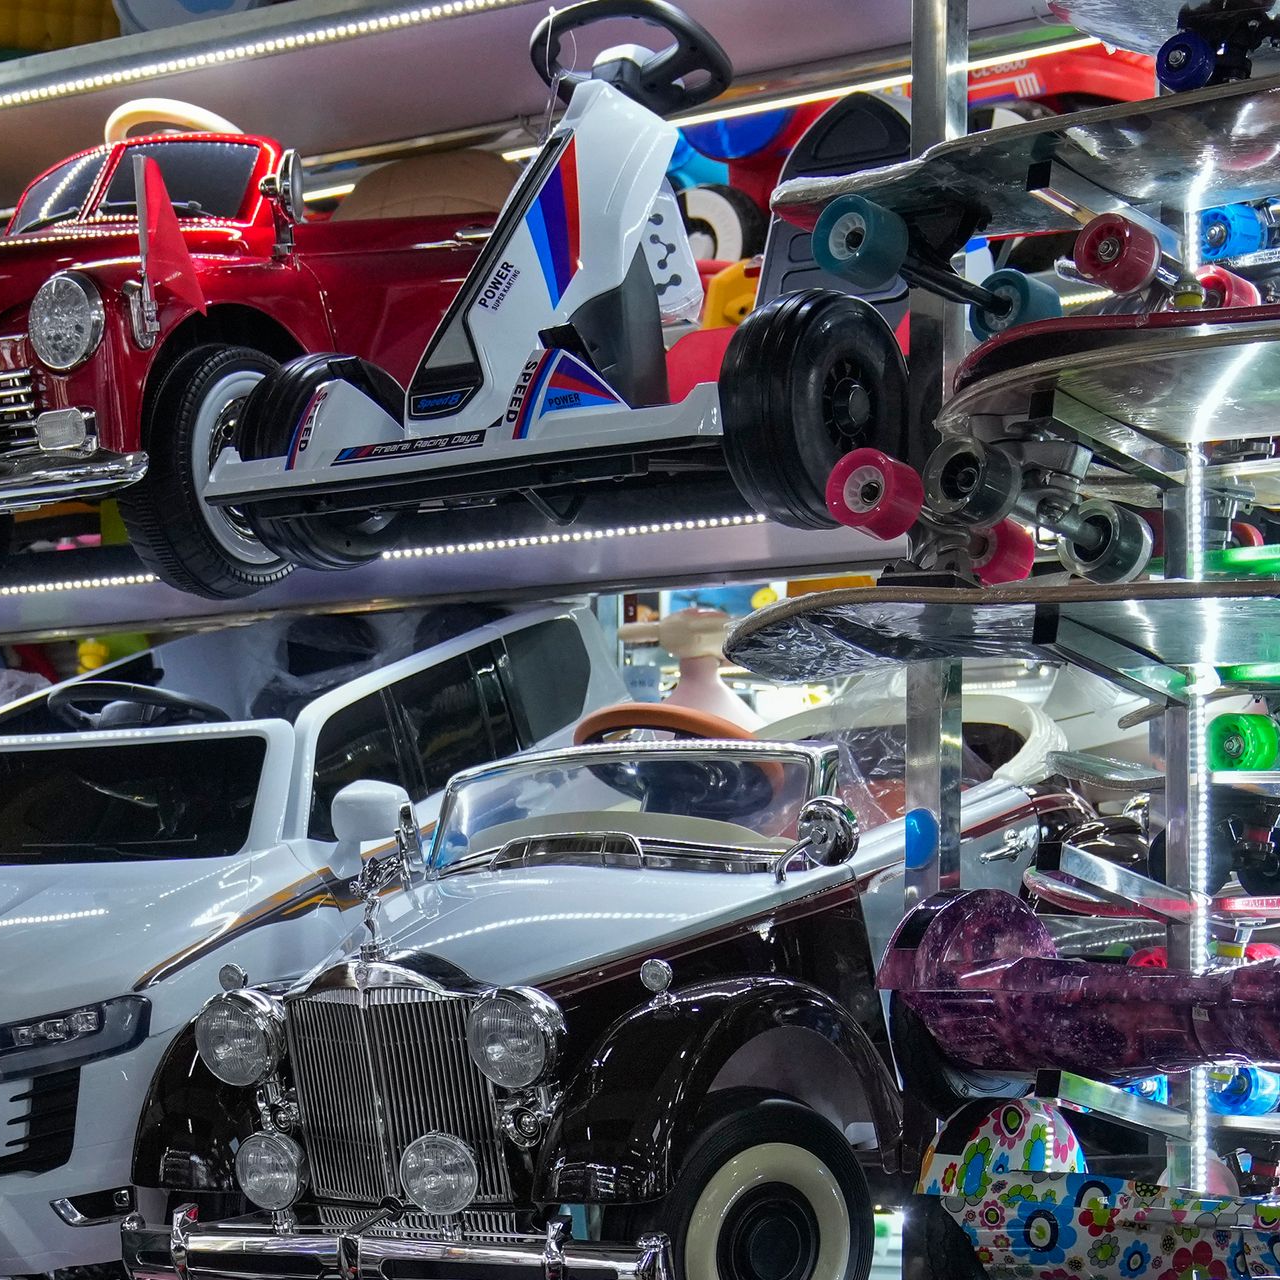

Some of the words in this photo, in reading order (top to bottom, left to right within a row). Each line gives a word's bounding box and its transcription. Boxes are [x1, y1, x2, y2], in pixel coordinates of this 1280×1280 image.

[478, 261, 514, 309] POWER
[491, 291, 507, 311] SUPER
[502, 269, 521, 295] KARTING
[506, 360, 538, 422] SPEED
[548, 393, 581, 407] POWER
[415, 437, 449, 449] Racing
[451, 433, 479, 445] Days
